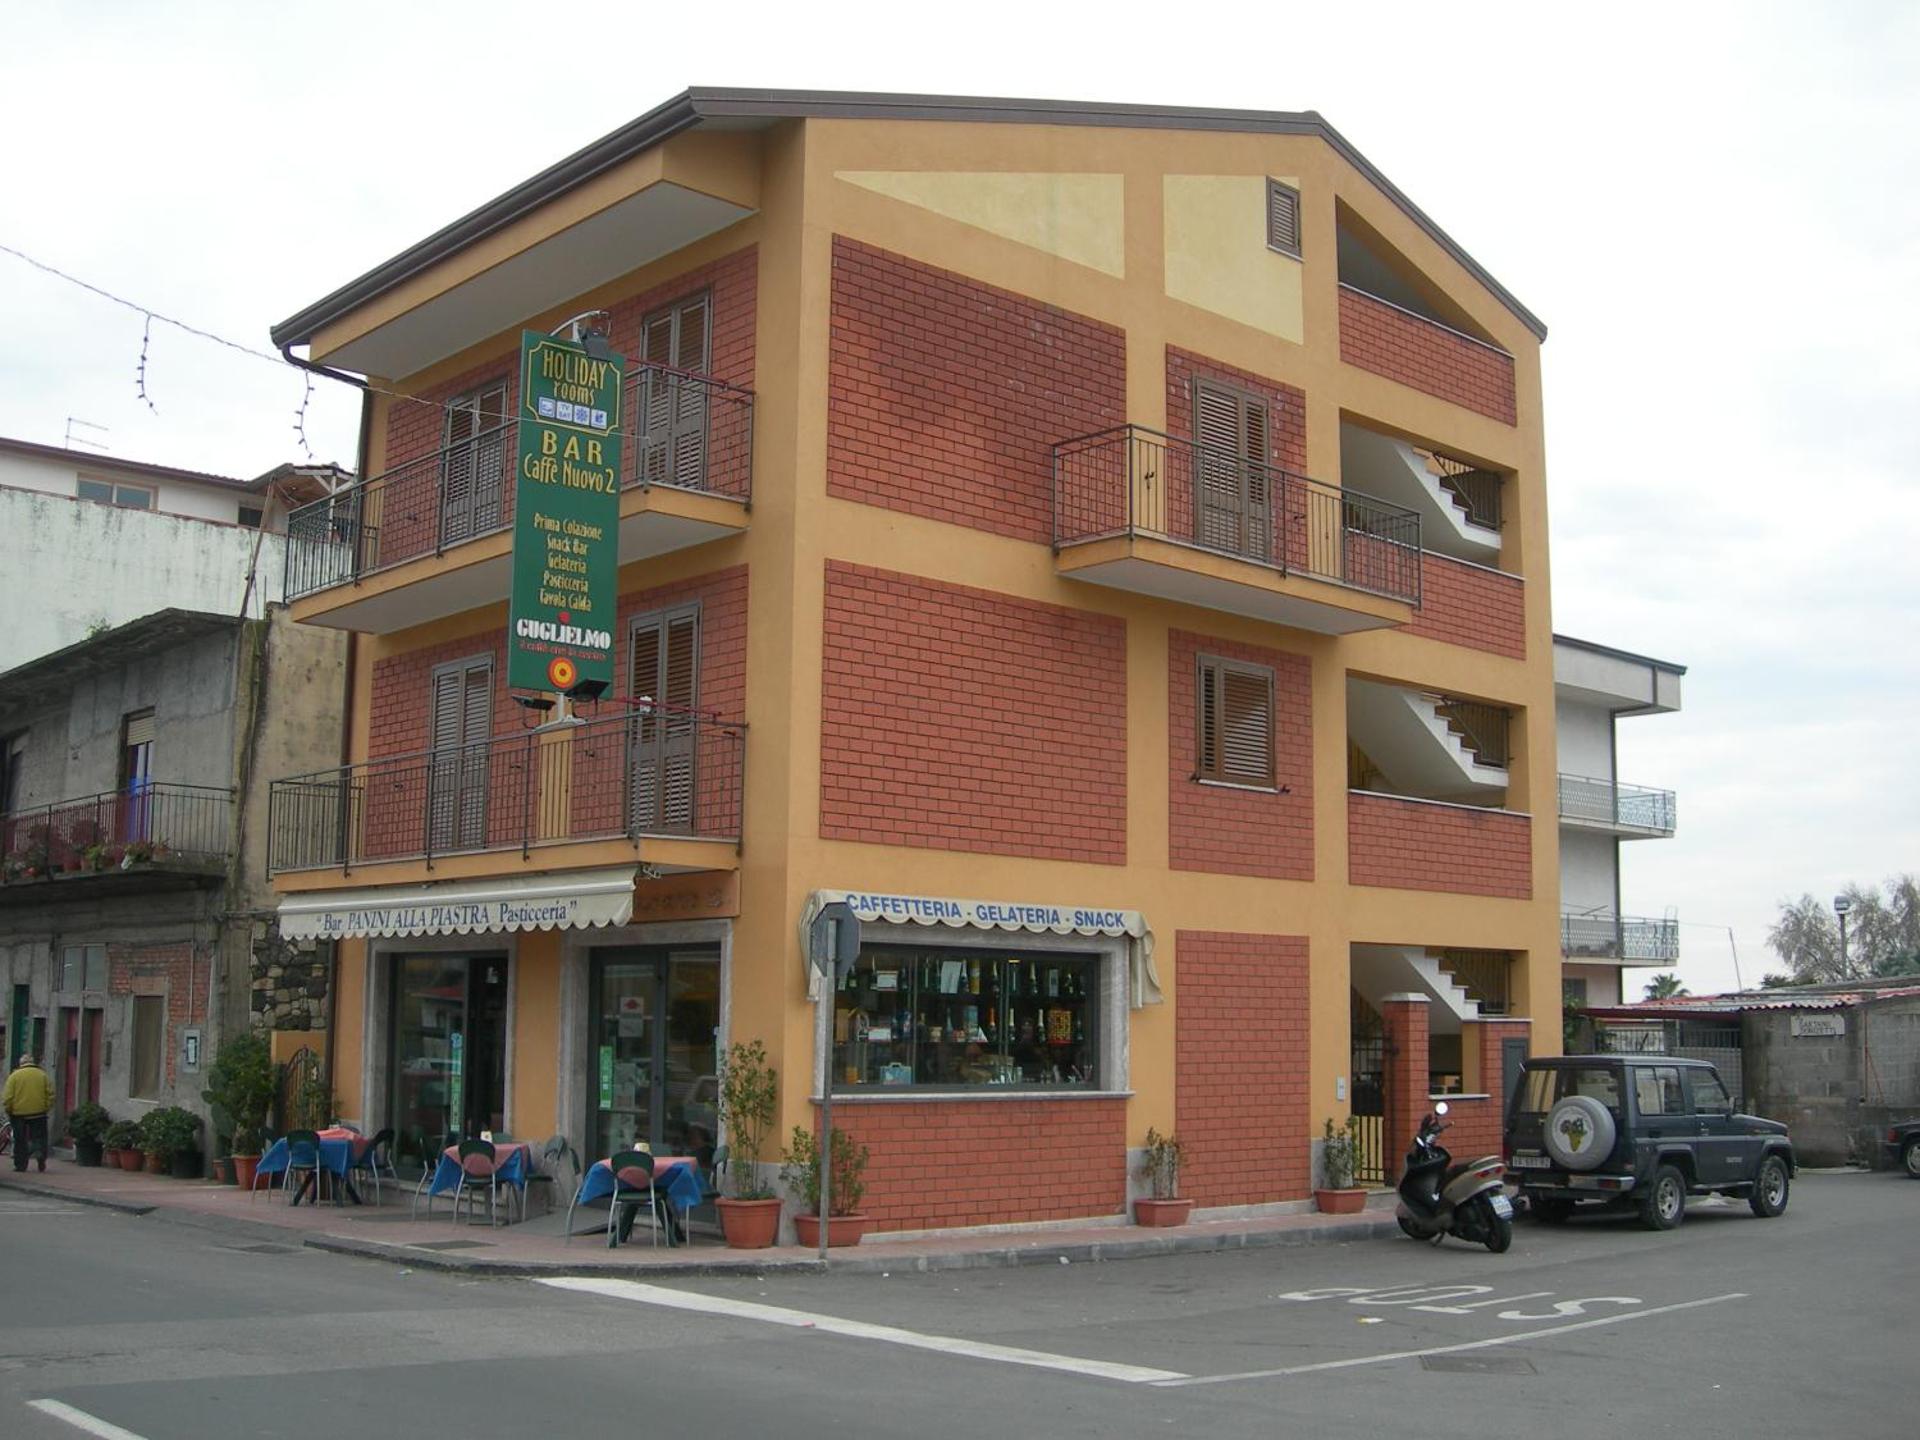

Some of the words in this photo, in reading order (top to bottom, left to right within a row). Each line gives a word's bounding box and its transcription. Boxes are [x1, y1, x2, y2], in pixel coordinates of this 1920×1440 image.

[543, 350, 608, 390] HOLIDAY
[553, 380, 595, 406] rooms
[542, 430, 603, 465] BAR
[562, 460, 603, 492] Nuovo
[605, 468, 616, 493] 2
[534, 513, 560, 532] Prima
[562, 518, 602, 541] Colazione
[547, 534, 570, 552] Snack
[573, 538, 588, 555] Bar
[548, 552, 587, 574] Gelateria
[539, 588, 567, 608] Tavola
[568, 593, 592, 612] Calda
[347, 910, 392, 931] PANINI
[393, 909, 427, 929] ALLA
[429, 904, 490, 927] PIASTRA
[846, 894, 962, 919] CAFFETTERIA
[976, 904, 1061, 926] GELATERIA
[1074, 910, 1126, 928] SNACK
